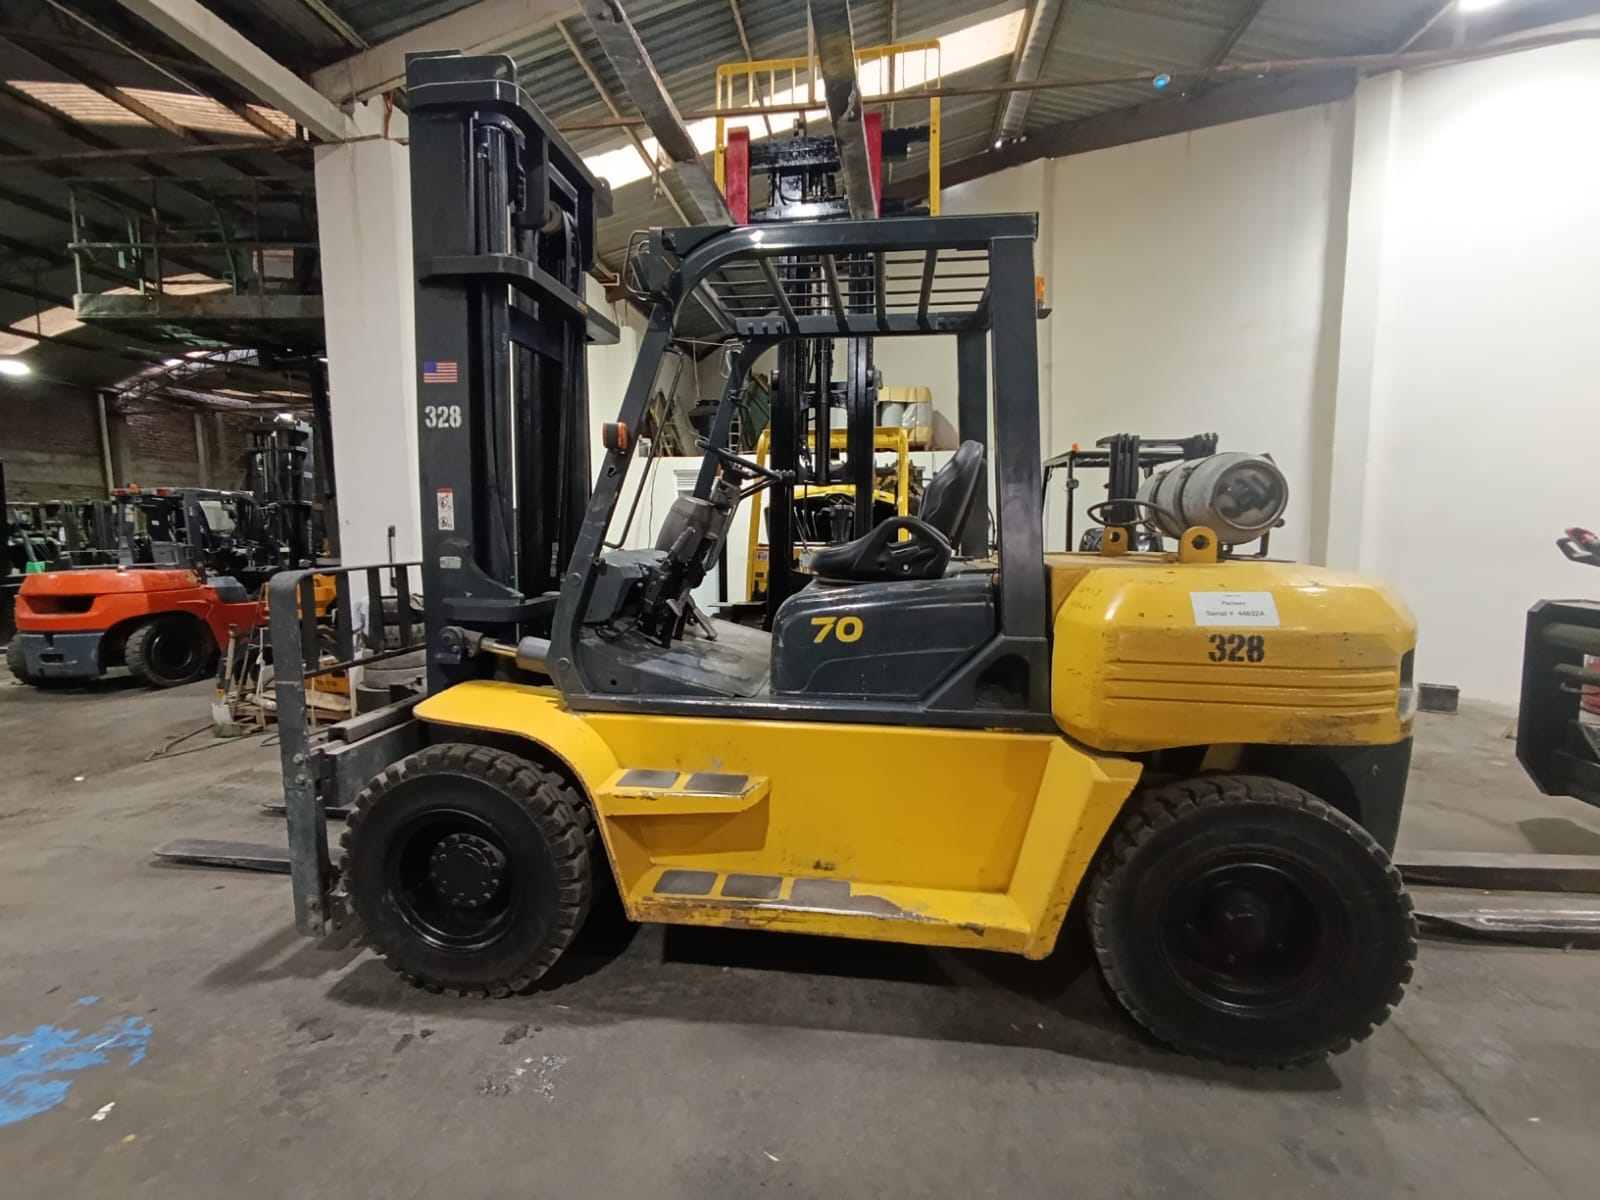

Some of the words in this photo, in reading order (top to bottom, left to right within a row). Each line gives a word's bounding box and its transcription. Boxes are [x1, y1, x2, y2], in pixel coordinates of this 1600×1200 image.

[425, 405, 462, 428] 328
[811, 616, 863, 643] 70
[1208, 633, 1264, 662] 328
